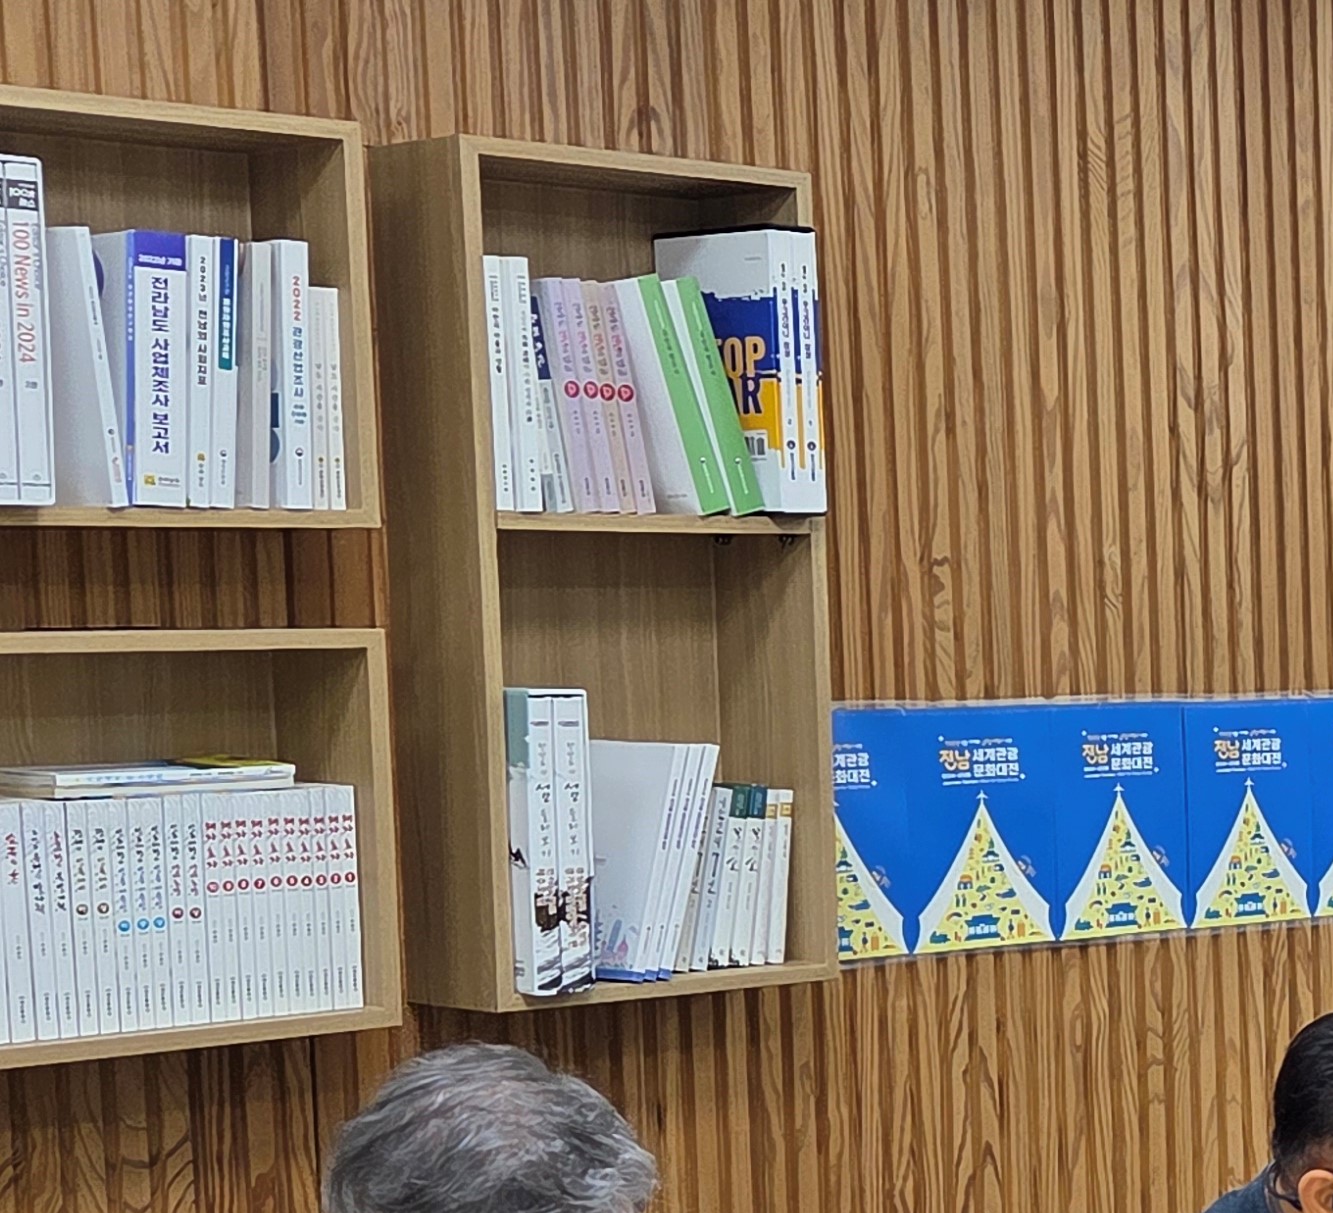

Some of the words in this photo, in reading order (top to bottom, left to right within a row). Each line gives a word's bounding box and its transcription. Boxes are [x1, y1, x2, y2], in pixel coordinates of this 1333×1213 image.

[12, 222, 30, 250] 100
[15, 254, 32, 299] News
[151, 276, 170, 333] 전라남도
[292, 275, 301, 322] 2022
[17, 322, 36, 363] 2024
[714, 335, 766, 379] OP
[151, 338, 170, 407] 사업체조사
[151, 412, 170, 454] 보고서
[972, 746, 1019, 762] 세계관광
[1082, 743, 1109, 764] 전남
[1110, 741, 1154, 756] 세계관광
[1213, 739, 1240, 760] 전남
[1241, 738, 1282, 752] 세계관광
[939, 749, 971, 771] 전남
[1111, 756, 1154, 771] 문화대전
[1241, 752, 1282, 766] 문화대전
[833, 768, 870, 784] 화대전
[973, 762, 1020, 778] 문화대전
